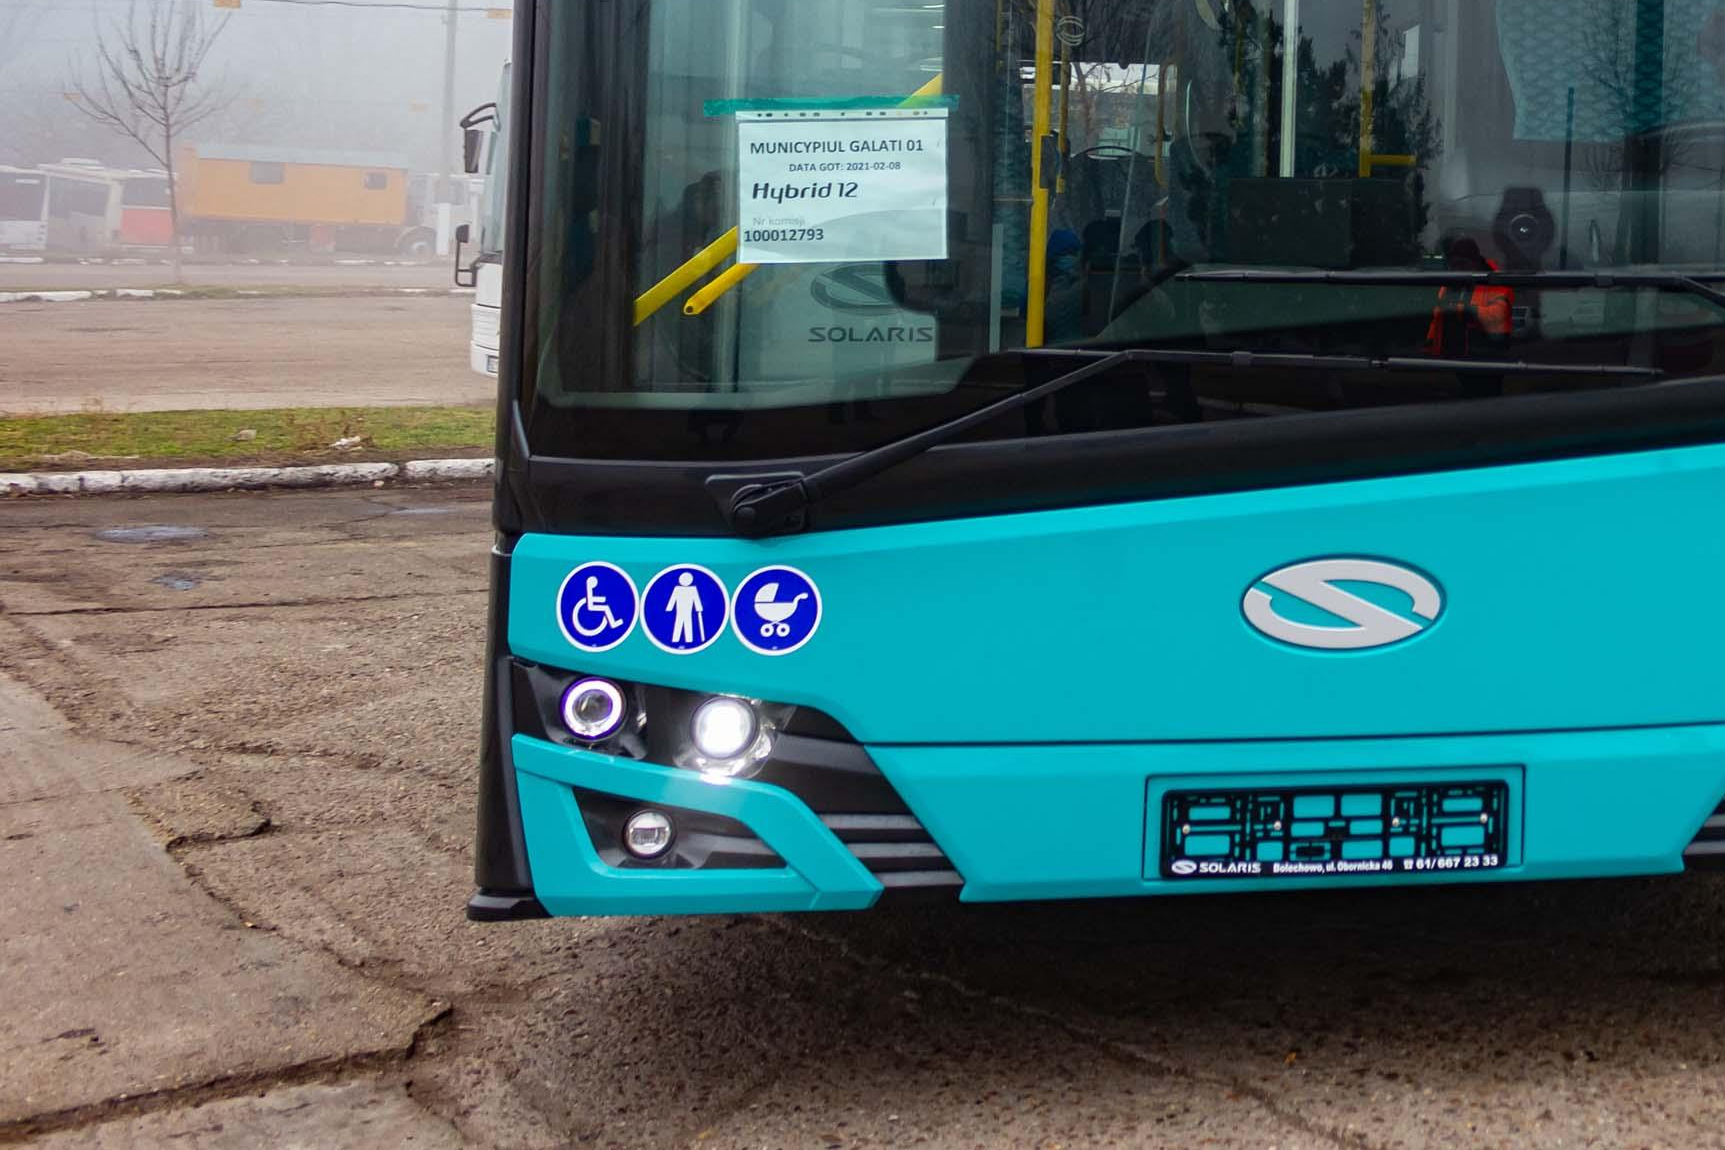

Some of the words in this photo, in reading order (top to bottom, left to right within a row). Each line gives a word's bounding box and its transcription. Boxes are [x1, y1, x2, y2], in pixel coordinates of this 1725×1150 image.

[750, 141, 845, 154] MUNICYPIUL
[850, 140, 901, 152] GALATI
[906, 140, 923, 151] 01
[789, 163, 816, 172] DATA
[819, 162, 844, 171] GOT:
[846, 161, 901, 171] 2021-02-08
[752, 182, 832, 204] Hybrid
[837, 182, 859, 198] 12
[744, 228, 824, 242] 100012793
[808, 327, 933, 342] SOLARIS
[1199, 862, 1261, 873] SOLARIS
[1273, 861, 1325, 874] Bolechowo,
[1337, 860, 1380, 872] Obornicka
[1464, 856, 1480, 868] 23
[1482, 854, 1498, 867] 33
